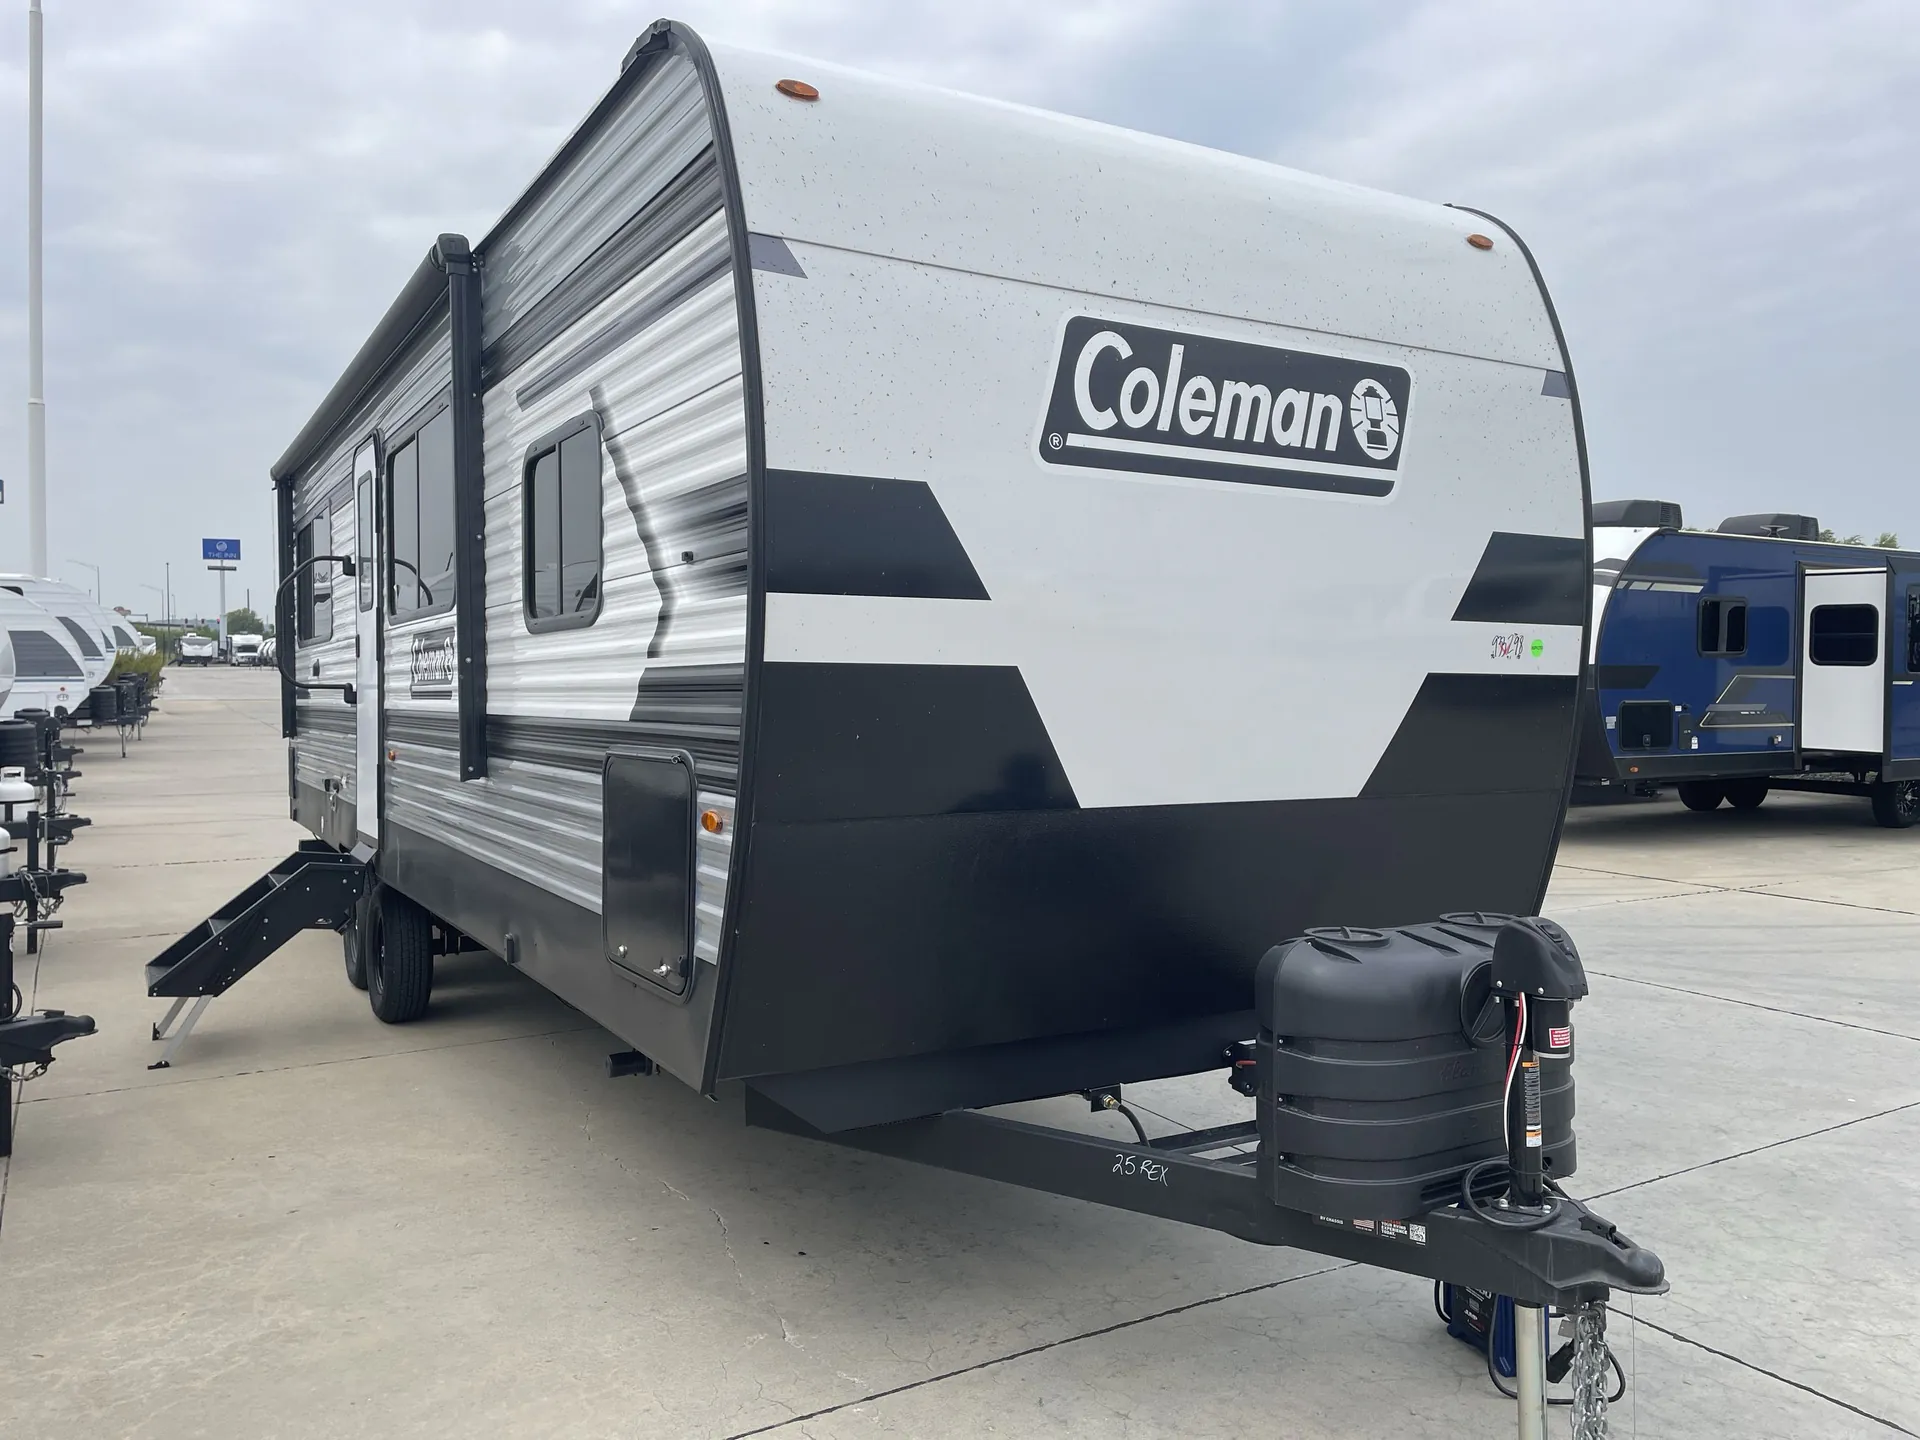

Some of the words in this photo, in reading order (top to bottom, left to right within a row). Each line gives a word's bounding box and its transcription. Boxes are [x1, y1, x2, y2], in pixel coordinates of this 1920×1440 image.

[1074, 330, 1343, 452] Coleman
[412, 637, 445, 684] Coleman
[1112, 1153, 1136, 1176] 25
